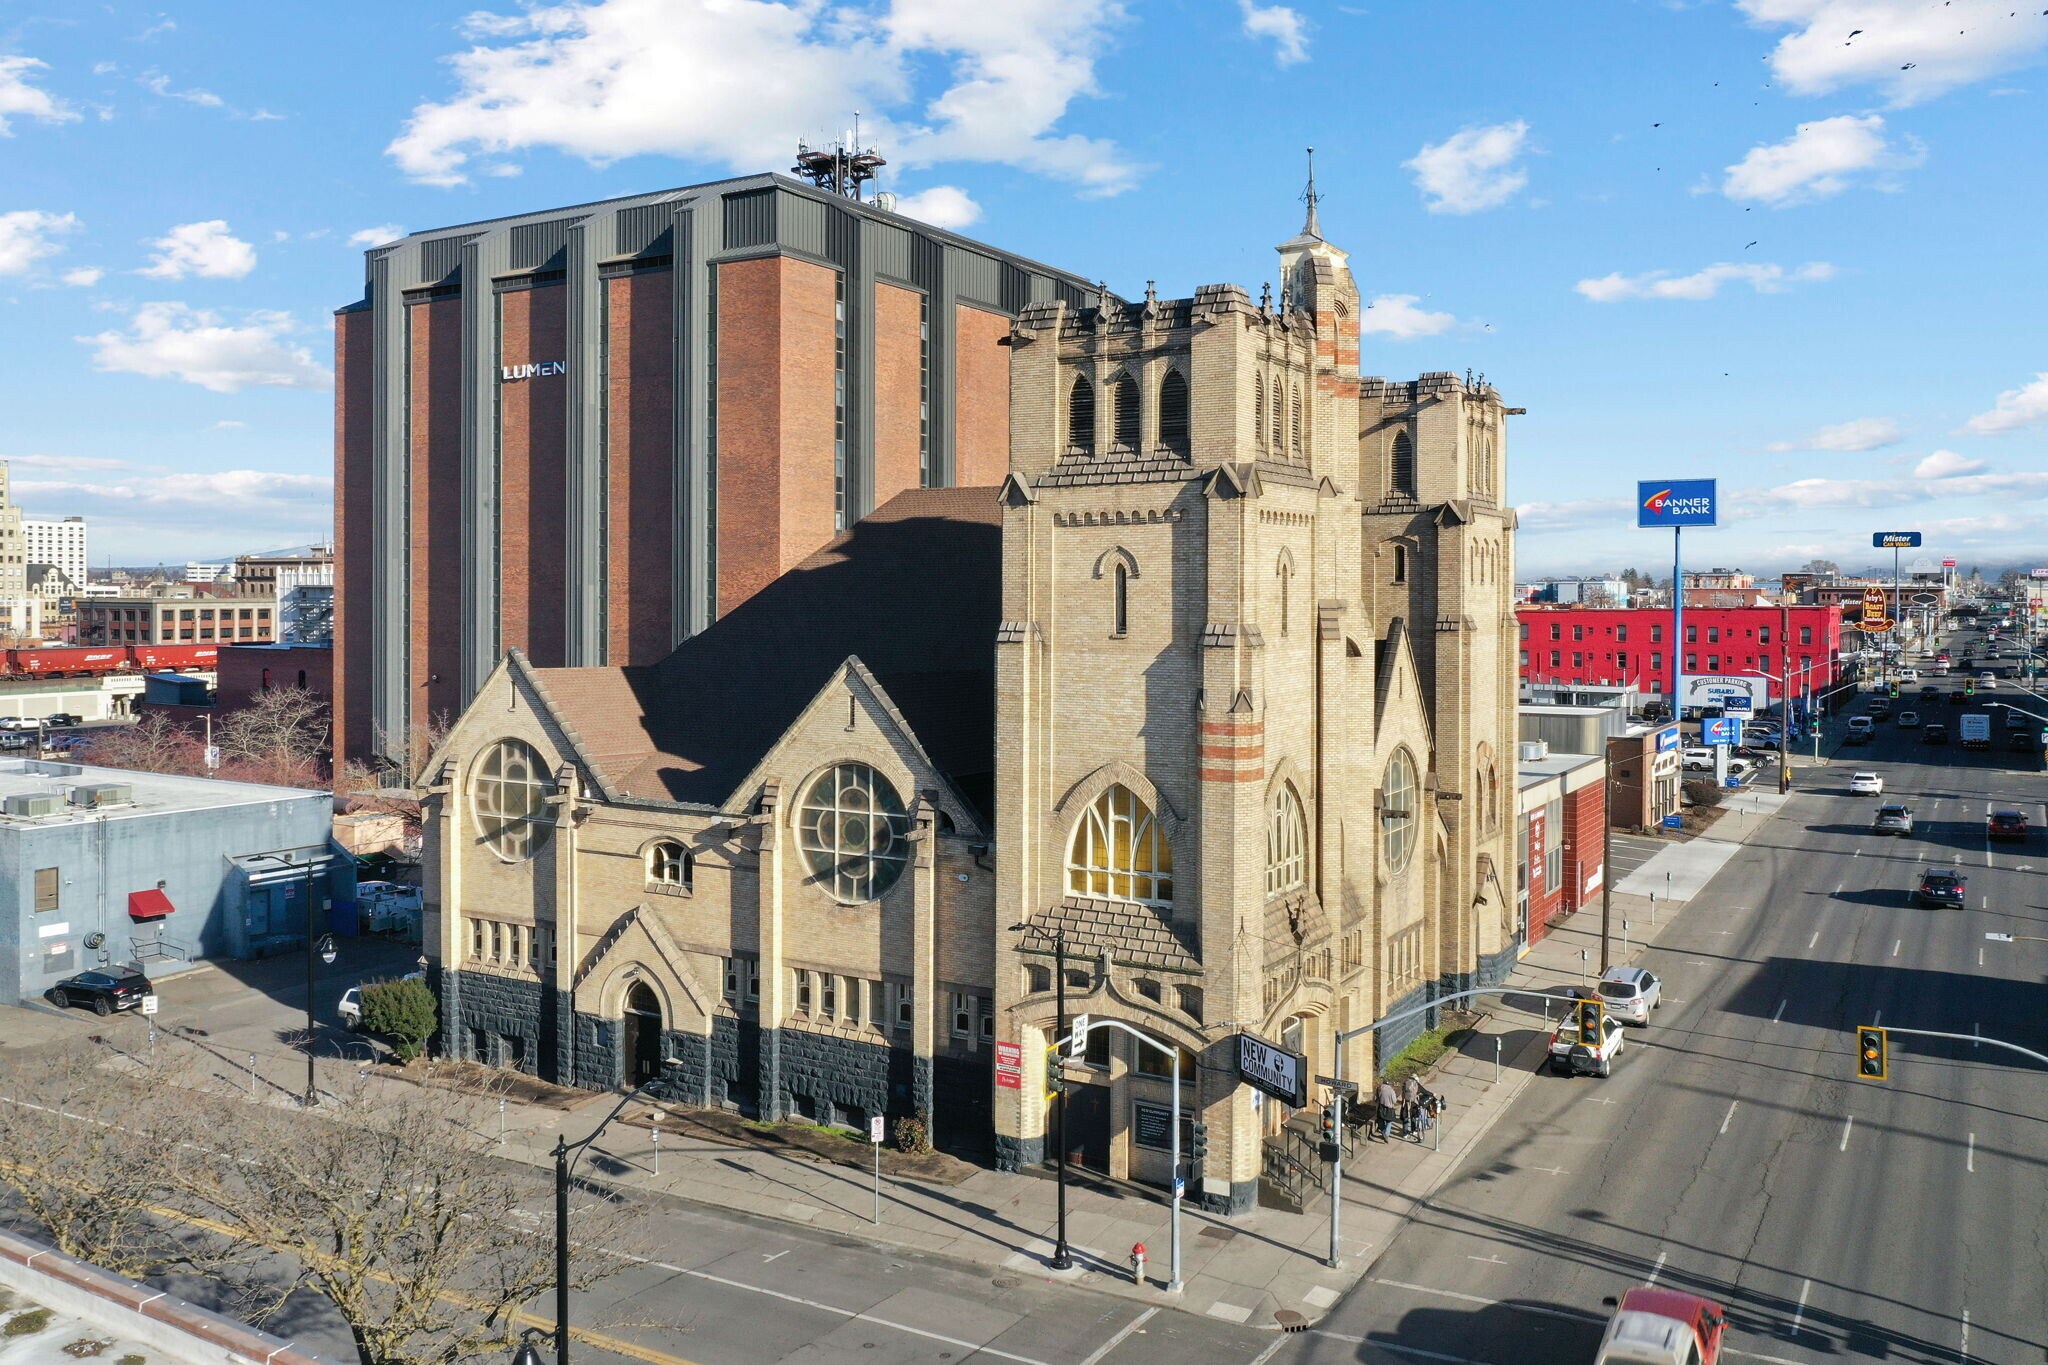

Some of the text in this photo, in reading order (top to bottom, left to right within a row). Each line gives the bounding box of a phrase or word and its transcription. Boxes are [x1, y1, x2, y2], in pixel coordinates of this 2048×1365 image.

[503, 361, 566, 380] LUMEN
[1655, 498, 1710, 508] BANNER
[1672, 506, 1710, 515] BANK
[1865, 594, 1882, 603] Arby's
[1865, 602, 1883, 610] ROAST
[1696, 678, 1747, 687] CUSTOMER PARKING
[1075, 1018, 1086, 1029] ONE
[1075, 1028, 1085, 1039] WAY
[1243, 1039, 1267, 1065] NEW
[1243, 1057, 1293, 1091] COMMUNITY
[1321, 1079, 1352, 1088] HOWARD
